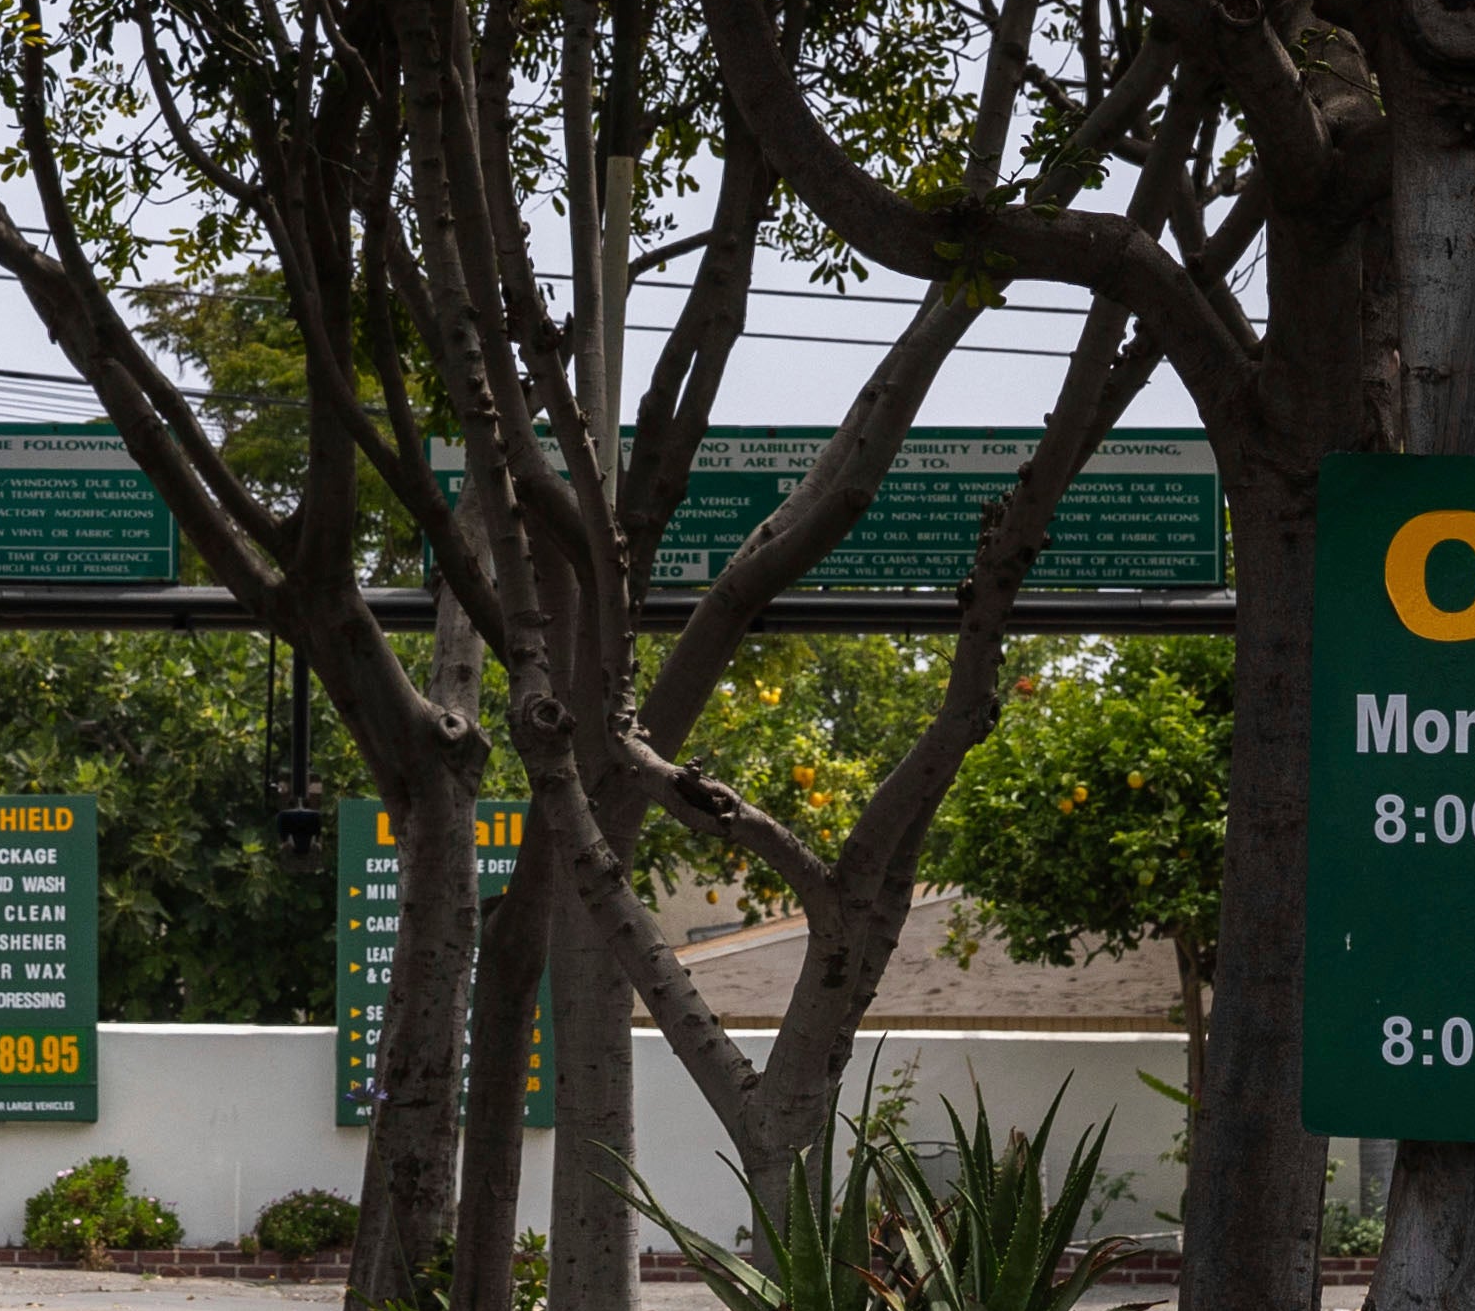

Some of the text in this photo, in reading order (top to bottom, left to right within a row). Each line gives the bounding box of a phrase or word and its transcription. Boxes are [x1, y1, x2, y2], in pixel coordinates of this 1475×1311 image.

[701, 443, 729, 452] NO
[983, 444, 1016, 454] FOR
[699, 457, 777, 467] BUT ARE
[85, 479, 110, 488] DUE
[120, 480, 137, 488] TO
[933, 483, 951, 491] OF
[1130, 483, 1183, 492] DUE TO
[701, 497, 750, 506] VEHICLE
[55, 509, 154, 518] MODIFICATIONS
[1100, 513, 1199, 522] MODIFICATIONS
[23, 877, 65, 893] WASH
[5, 906, 66, 921] CLEAN
[25, 964, 66, 979] WAX
[6, 1102, 33, 1111] LARGE
[35, 1102, 75, 1111] VEHICLES
